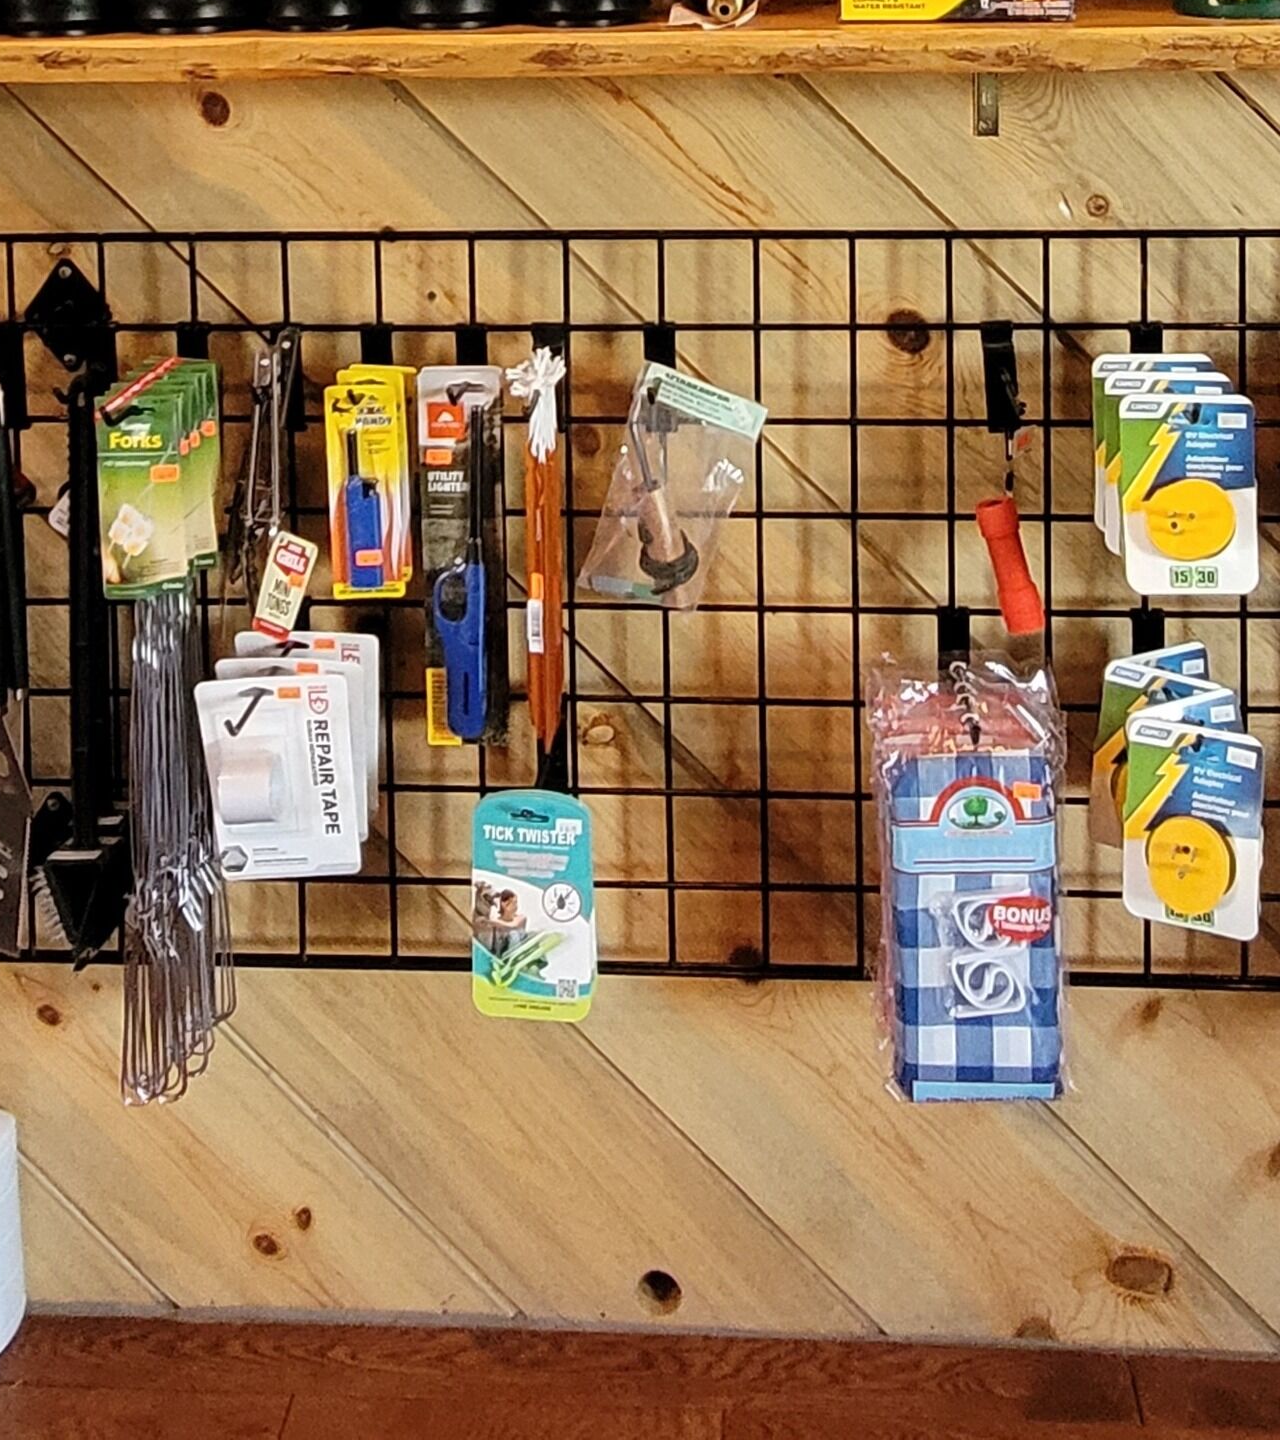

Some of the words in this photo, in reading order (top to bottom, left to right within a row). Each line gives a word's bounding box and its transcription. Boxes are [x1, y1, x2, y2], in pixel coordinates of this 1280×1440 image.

[109, 432, 163, 449] Forks
[427, 471, 465, 483] UTILITY
[427, 481, 470, 493] LIGHTER
[1174, 571, 1189, 584] 15
[1198, 571, 1215, 584] 30
[266, 592, 293, 616] TONGS
[313, 719, 335, 786] REPAIR
[321, 789, 342, 835] TAPE
[483, 825, 514, 841] TICK
[517, 827, 577, 846] TWISTER
[993, 905, 1053, 923] BONUS
